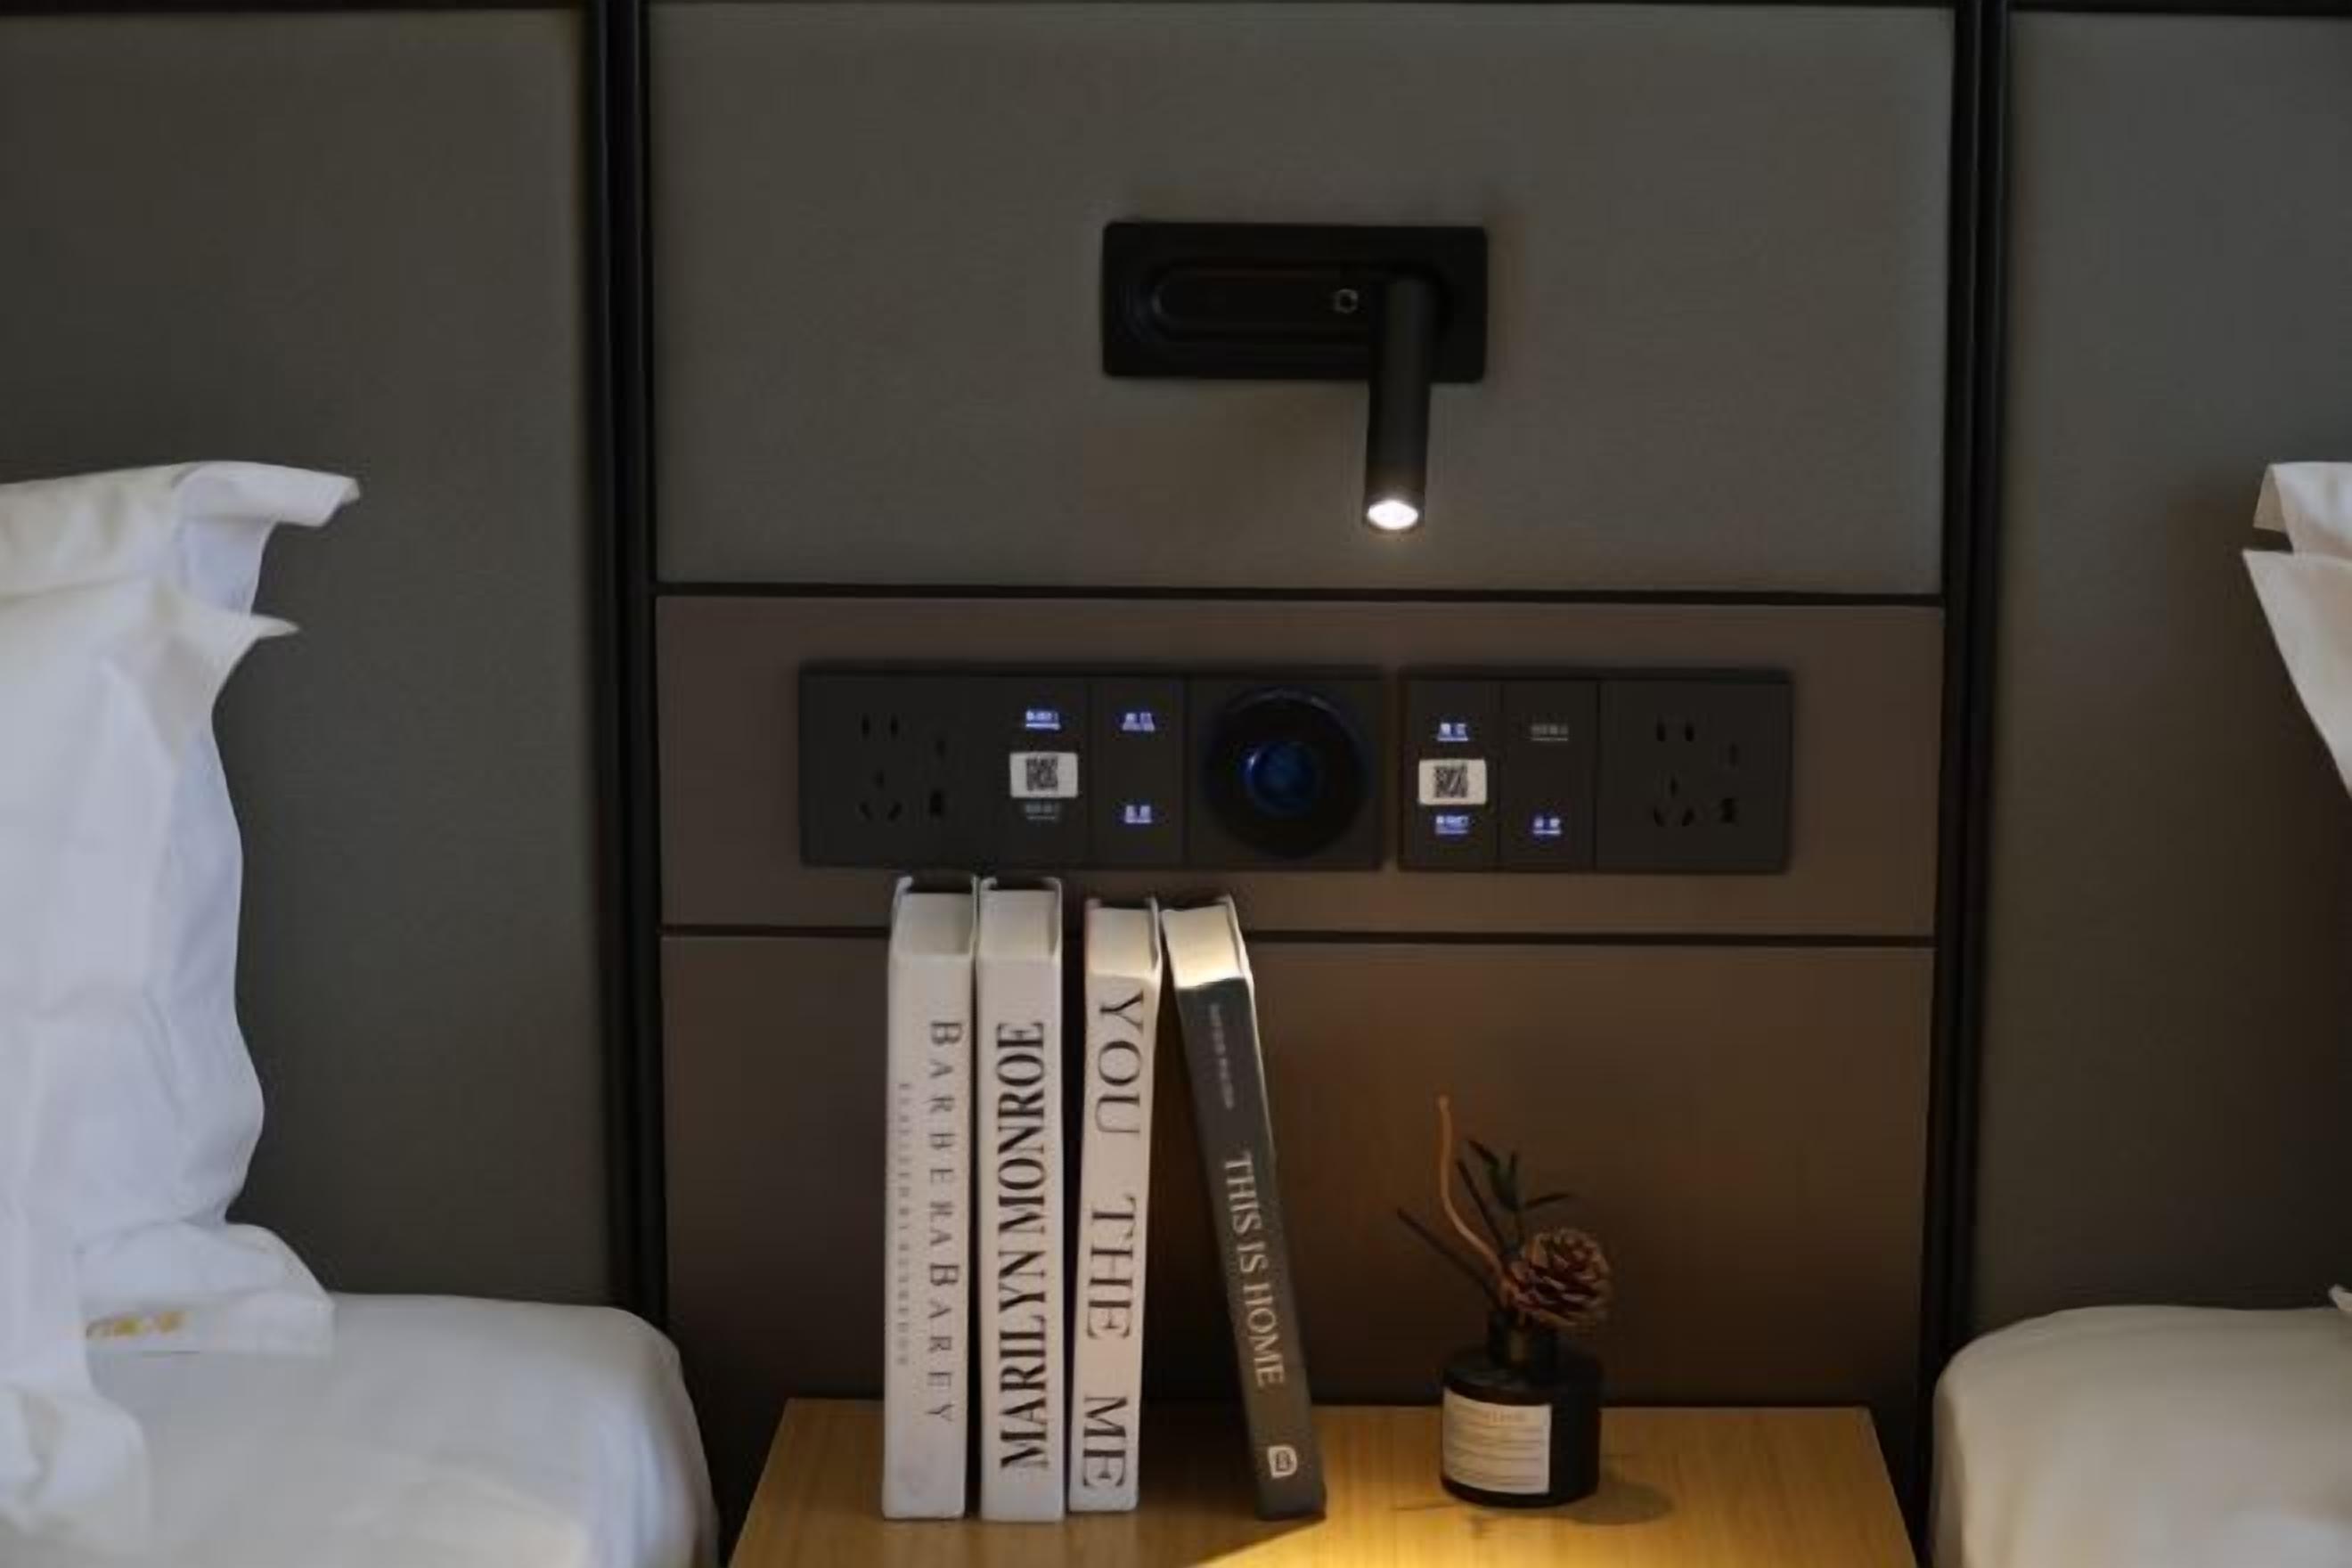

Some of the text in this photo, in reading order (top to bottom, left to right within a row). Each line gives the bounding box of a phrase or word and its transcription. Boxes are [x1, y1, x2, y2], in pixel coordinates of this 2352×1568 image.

[997, 1022, 1048, 1470] MARILYN MONROE
[1082, 990, 1145, 1488] YOU THE ME
[1224, 1151, 1285, 1386] THIS IS HOME
